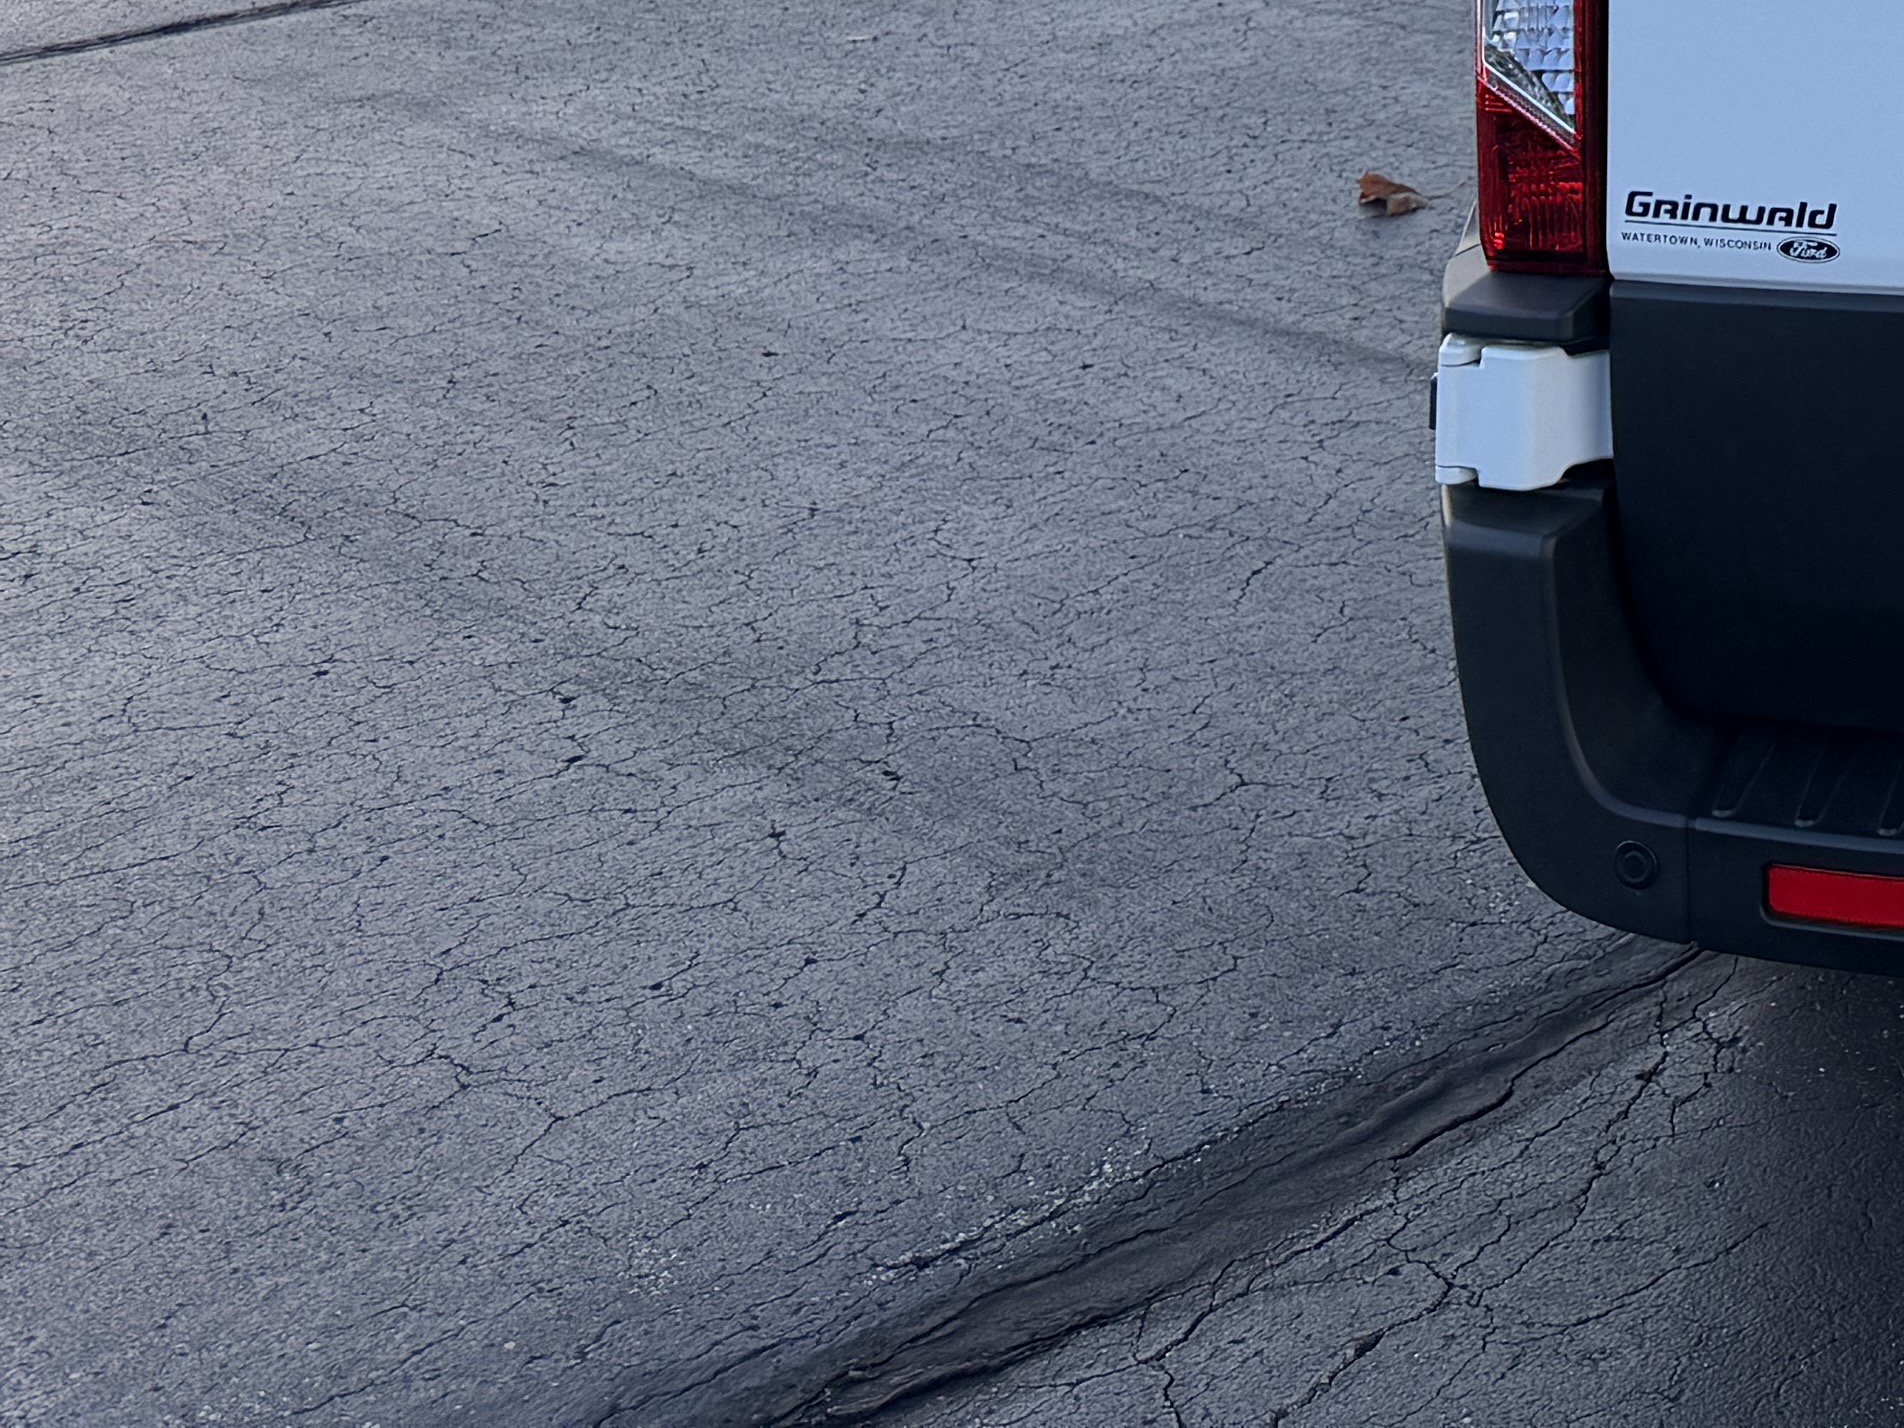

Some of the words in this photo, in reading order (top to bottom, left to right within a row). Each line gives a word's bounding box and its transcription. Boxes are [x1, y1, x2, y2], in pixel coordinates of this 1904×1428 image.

[1624, 190, 1838, 230] Grinwald
[1621, 232, 1701, 249] WATERTOWN,
[1703, 237, 1772, 251] WISCONSIN
[1788, 241, 1827, 260] Ford
